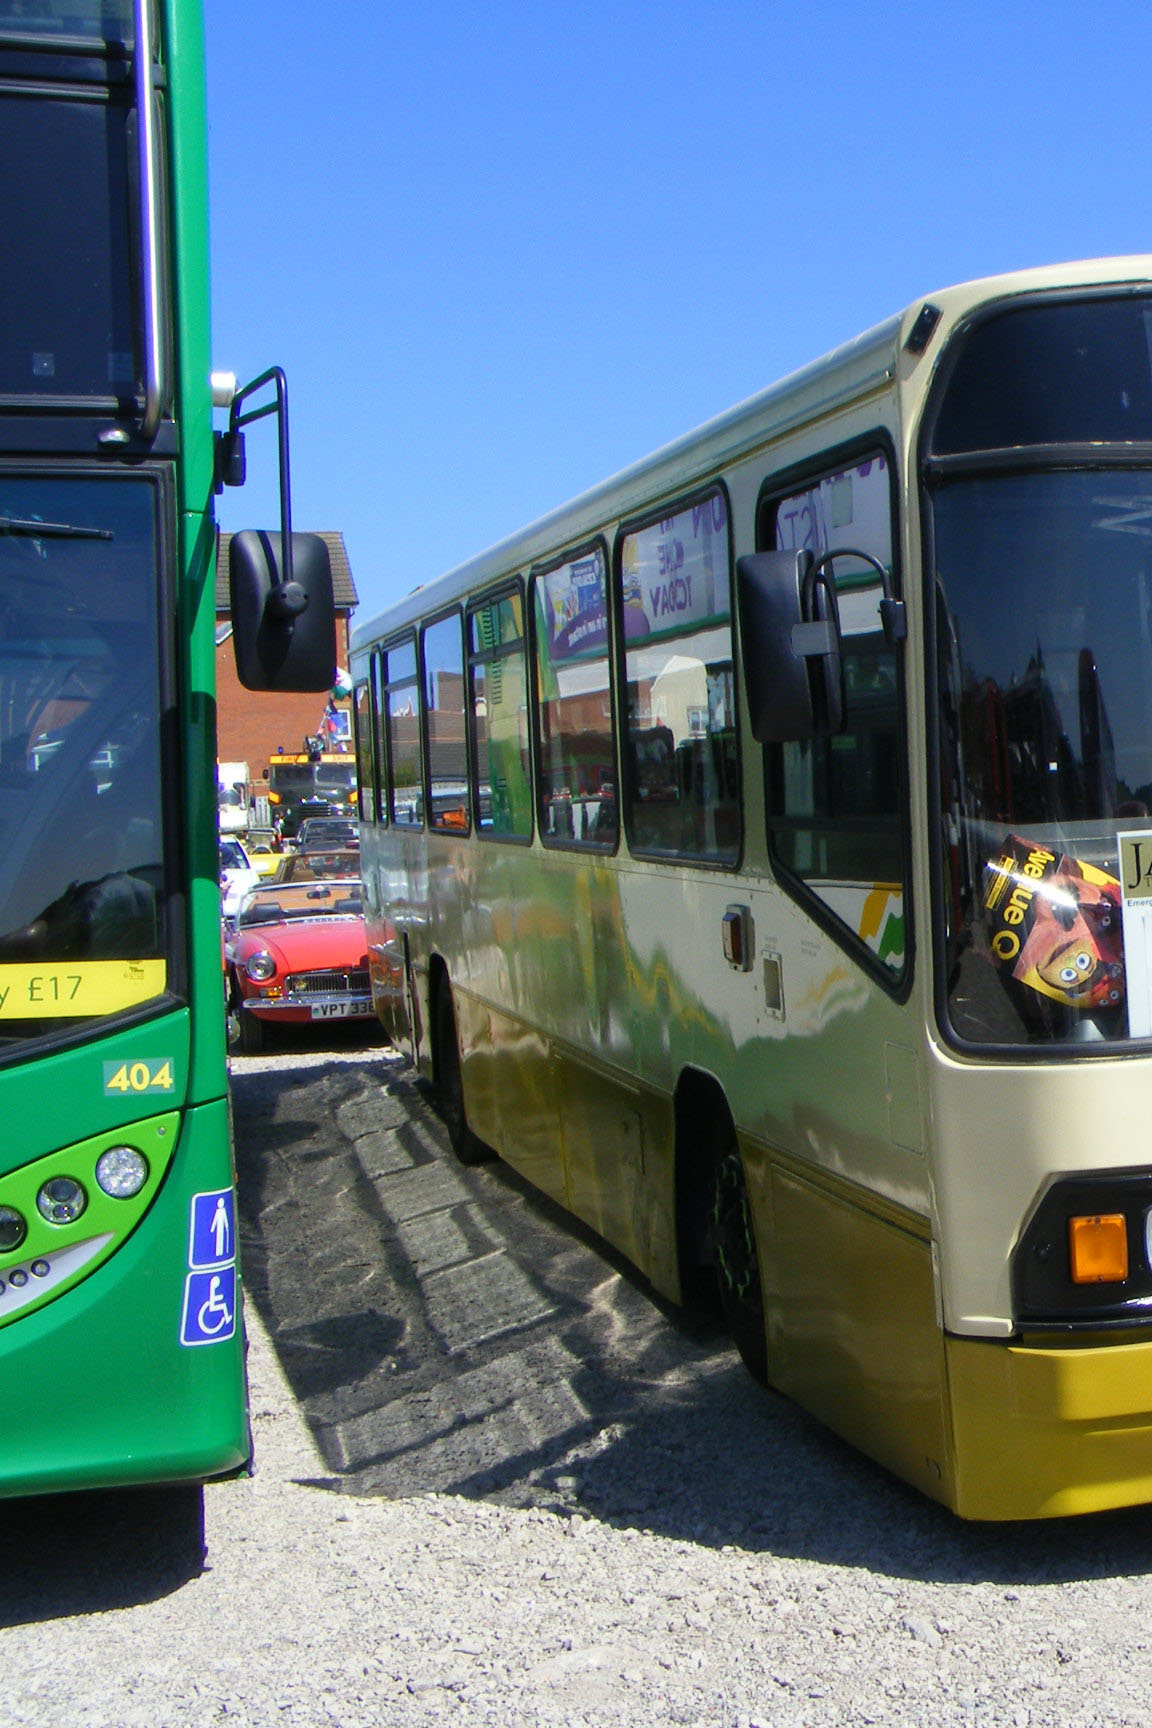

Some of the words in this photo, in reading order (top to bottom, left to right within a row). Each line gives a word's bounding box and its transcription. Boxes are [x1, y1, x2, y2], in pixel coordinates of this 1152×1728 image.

[1003, 847, 1056, 925] Aveue
[992, 930, 1020, 960] Q
[28, 976, 82, 1001] £17
[319, 1004, 347, 1016] VPT
[107, 1061, 173, 1092] 404
